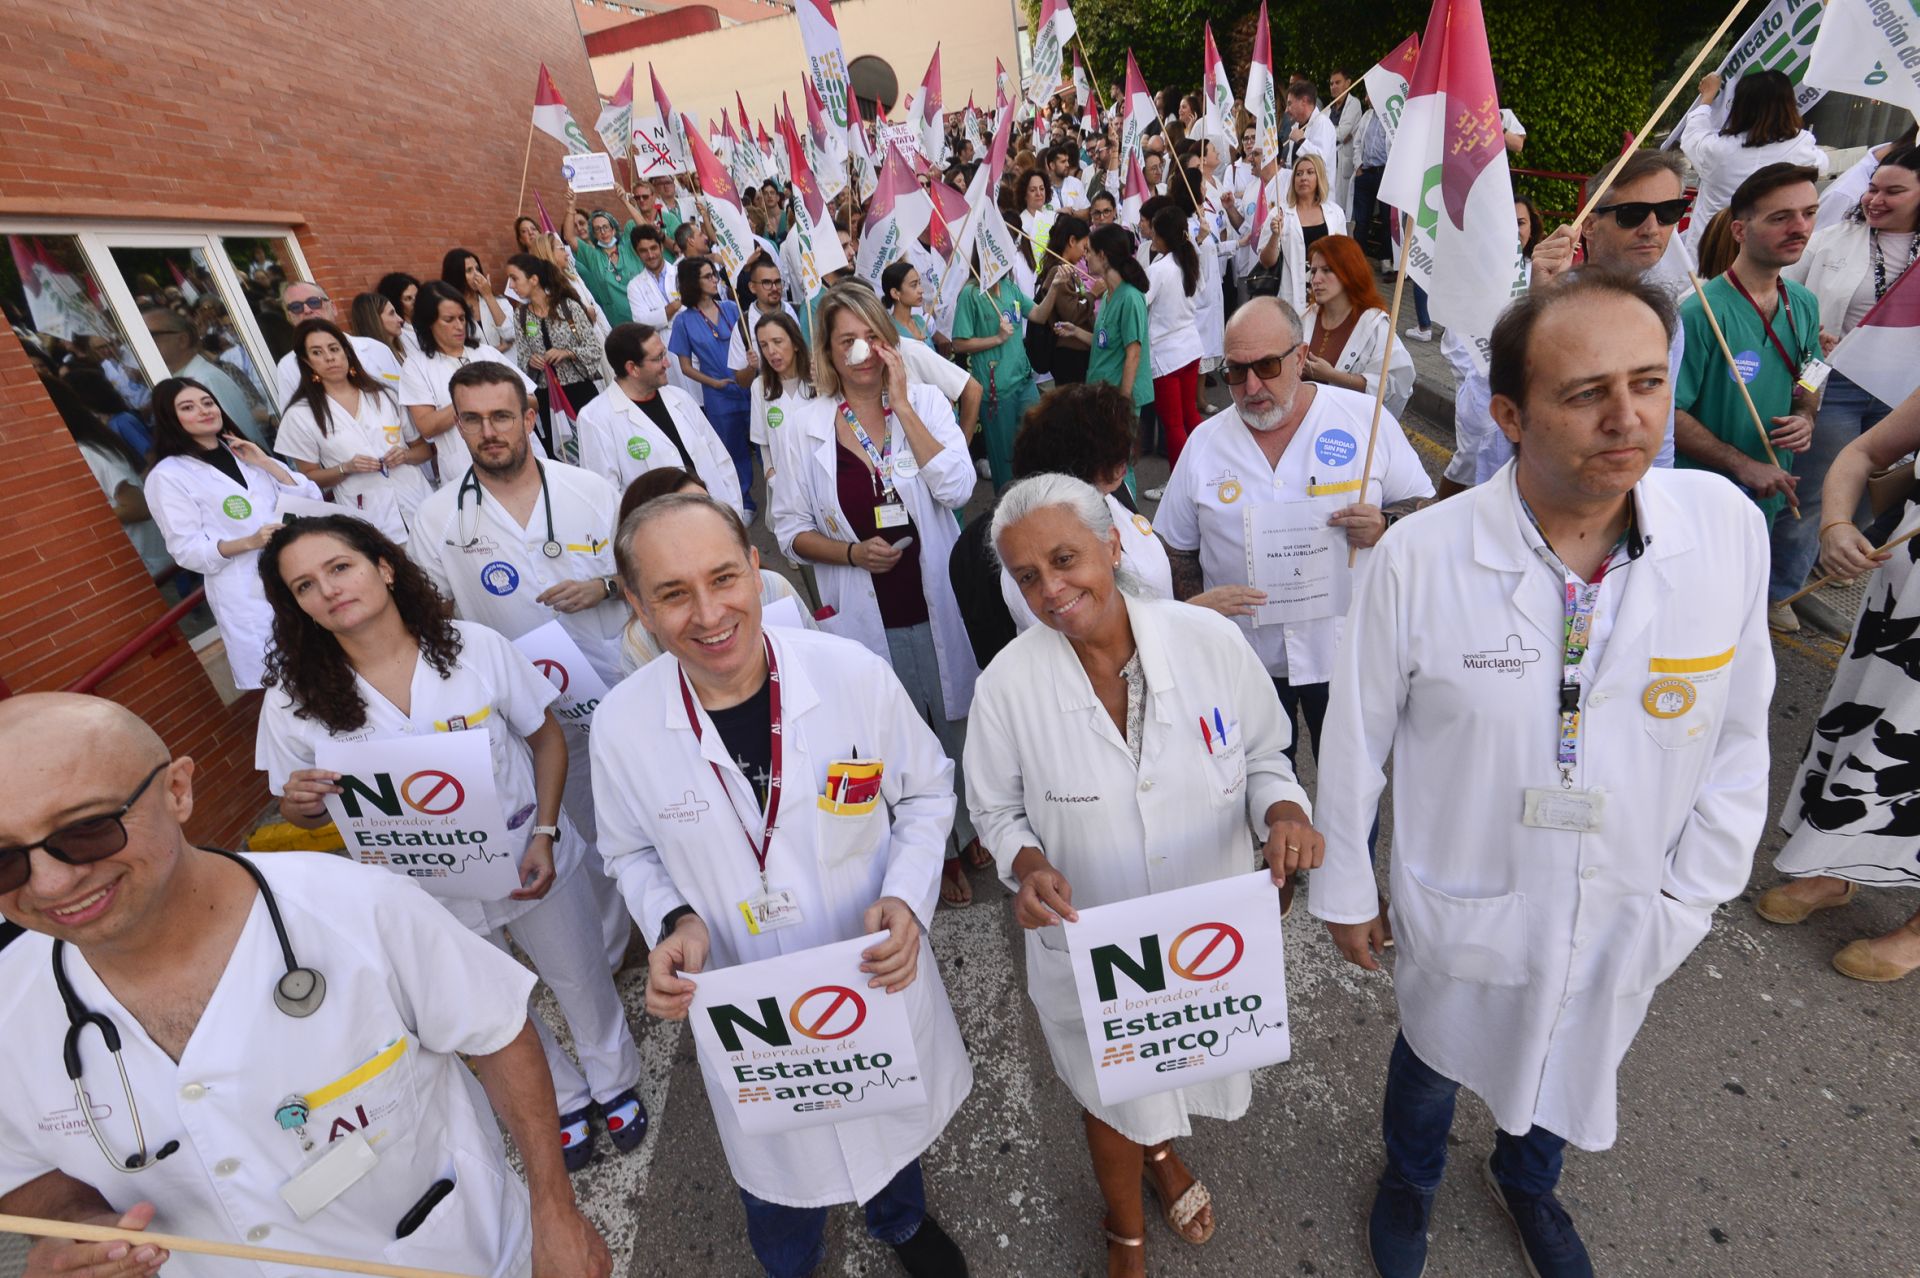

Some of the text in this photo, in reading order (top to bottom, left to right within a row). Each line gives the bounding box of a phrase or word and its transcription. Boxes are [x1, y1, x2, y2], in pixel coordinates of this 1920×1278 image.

[724, 229, 744, 262] Médico
[985, 229, 1008, 267] Médico
[1463, 658, 1521, 669] Murciano
[333, 769, 465, 818] NO
[352, 816, 458, 828] al borrador de
[354, 829, 487, 846] Estatuto
[1090, 922, 1244, 1002] NO
[1103, 980, 1230, 1015] al borrador de
[707, 985, 867, 1052] NO
[1103, 994, 1262, 1041] Estatuto
[731, 1039, 856, 1062] al borrador de
[1155, 1054, 1205, 1072] CESM
[733, 1052, 893, 1083] Estatuto
[793, 1100, 842, 1112] CESM
[38, 1119, 88, 1131] Murciano
